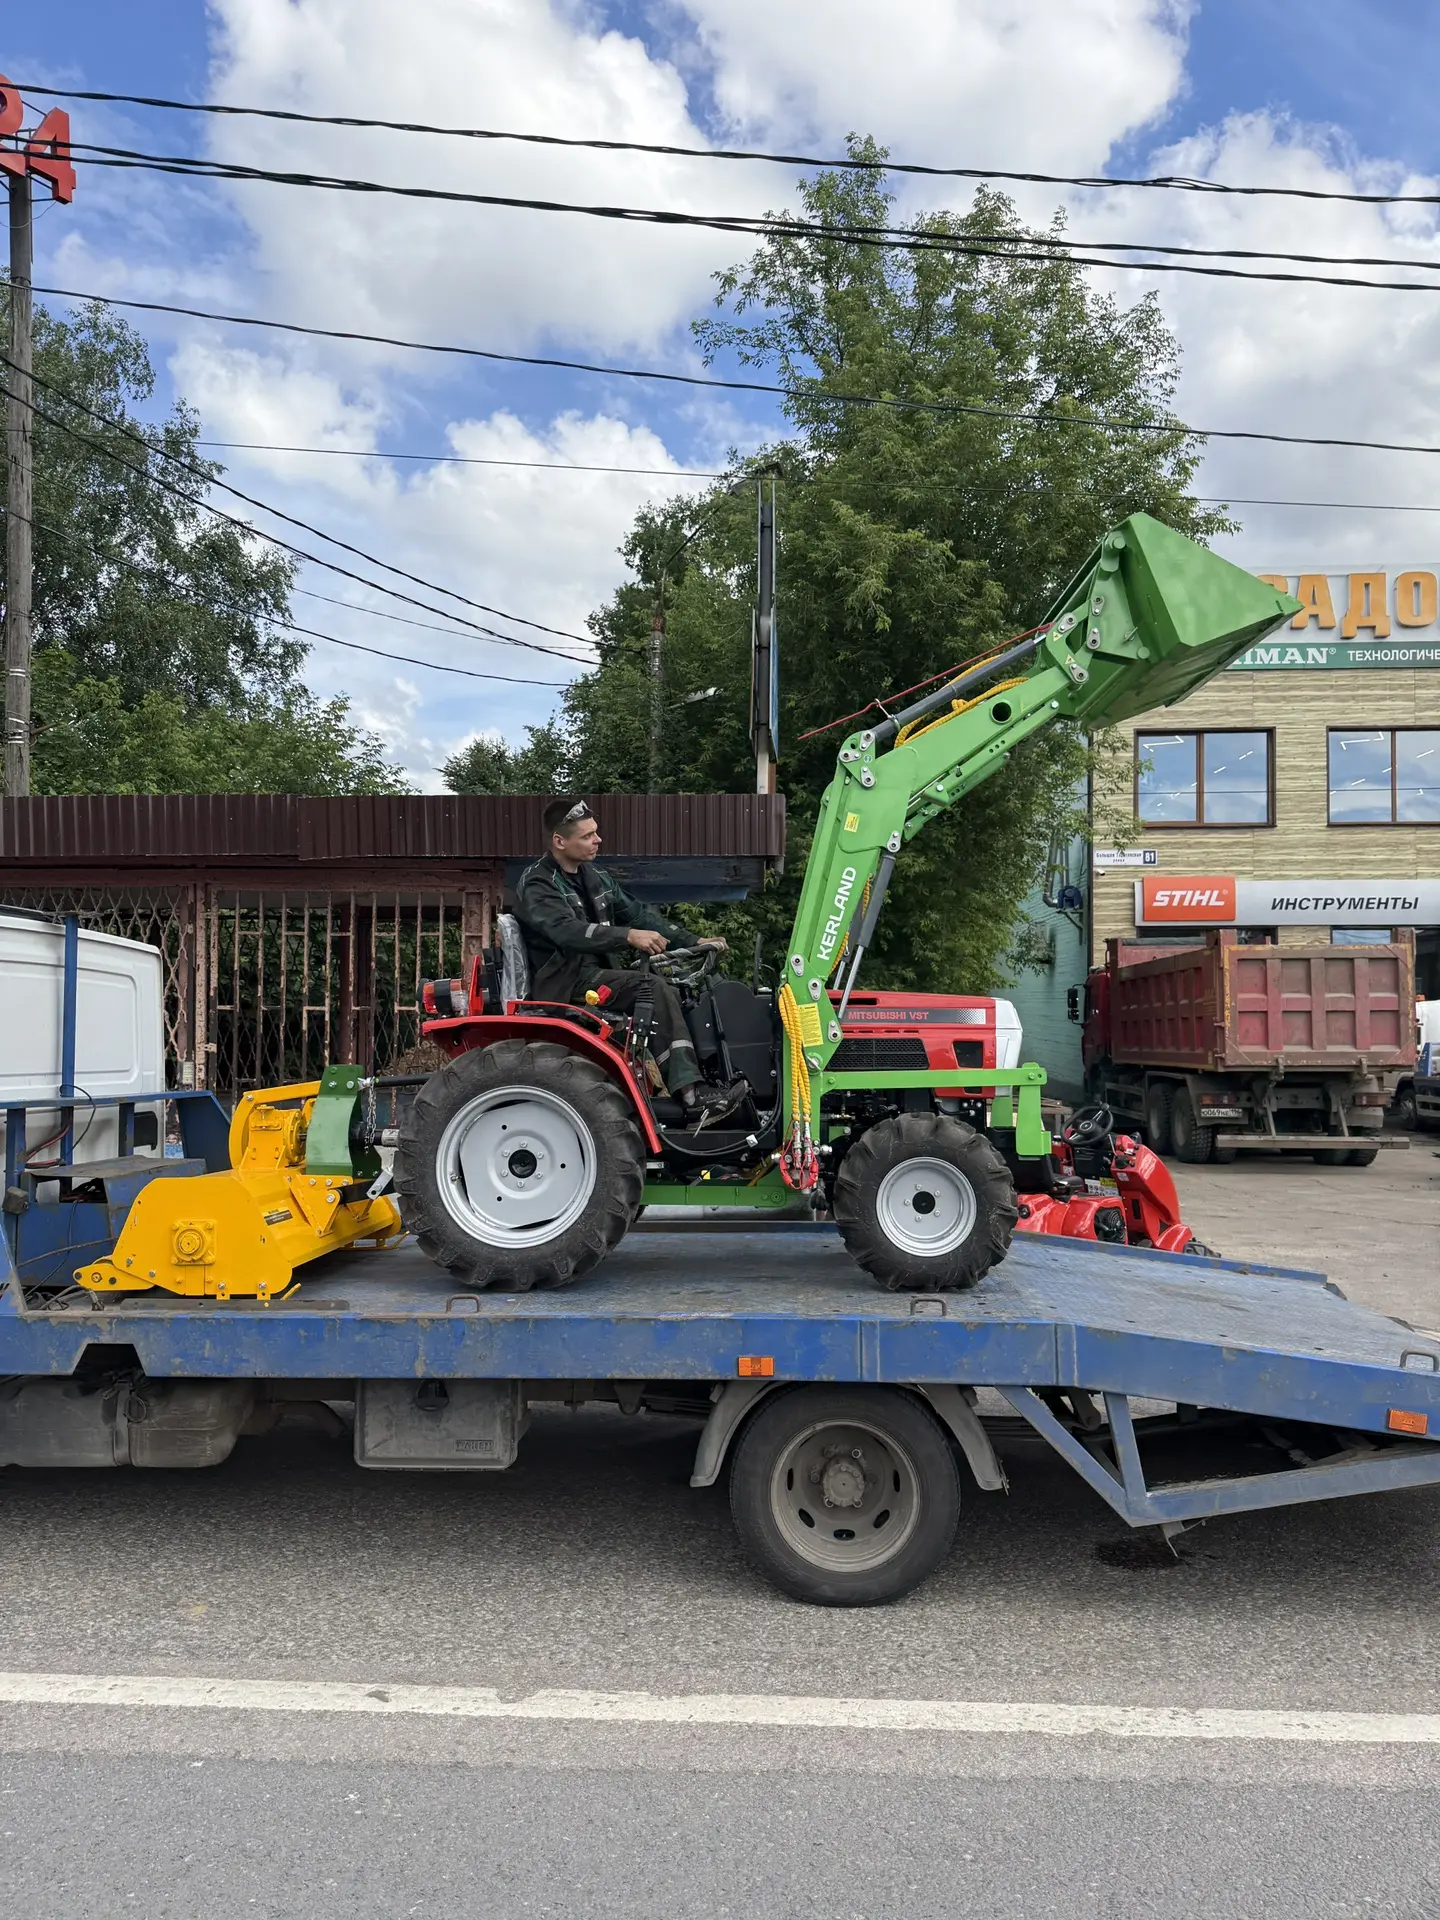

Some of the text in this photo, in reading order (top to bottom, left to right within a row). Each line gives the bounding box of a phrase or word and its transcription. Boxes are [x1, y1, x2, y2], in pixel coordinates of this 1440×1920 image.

[1145, 852, 1154, 862] 81
[1271, 896, 1419, 911] ИНСТРУМЕНТЫ
[817, 866, 857, 960] KERLAND
[848, 1011, 929, 1020] MITSUBISHI VST
